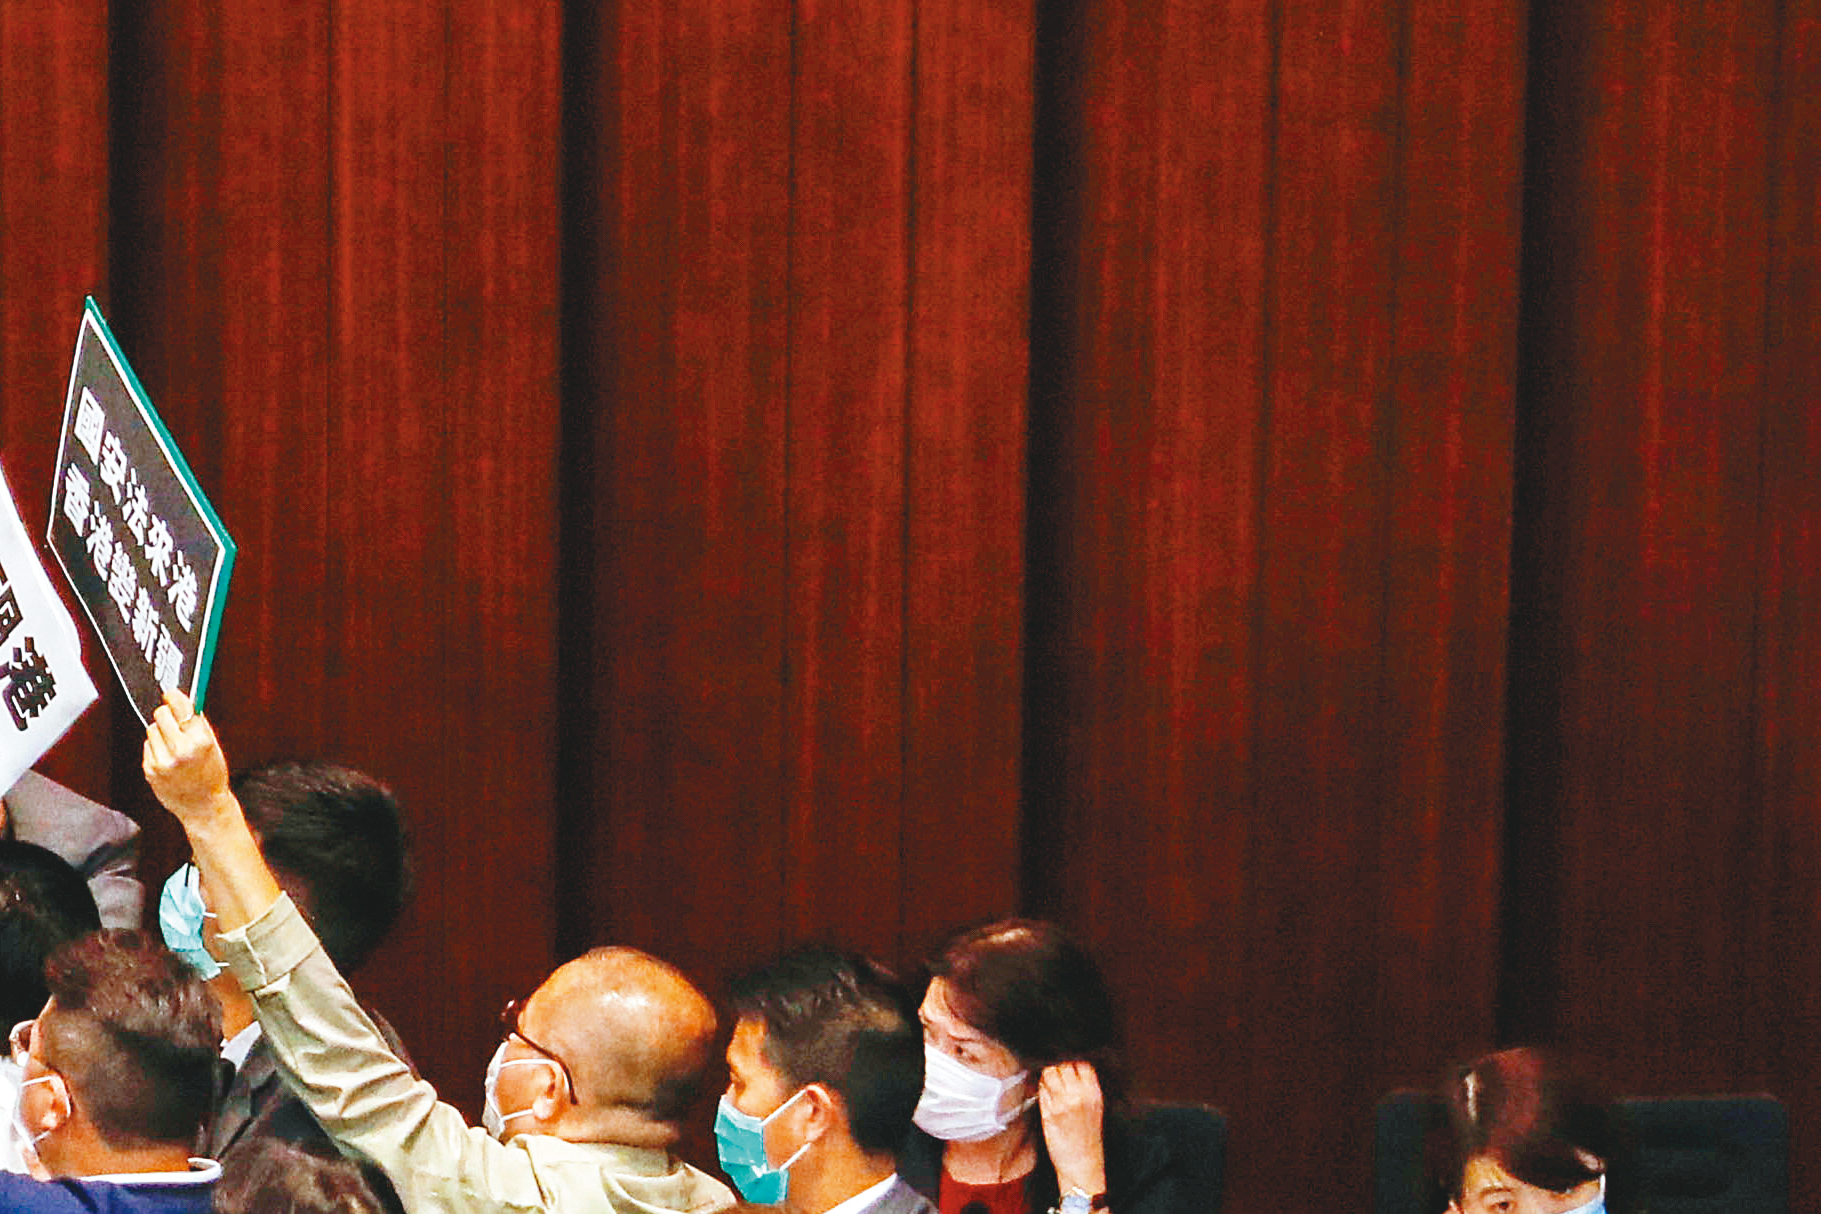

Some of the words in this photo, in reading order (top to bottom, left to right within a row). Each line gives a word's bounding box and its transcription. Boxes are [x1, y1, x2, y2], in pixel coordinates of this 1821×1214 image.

[74, 386, 198, 632] 國安法來港
